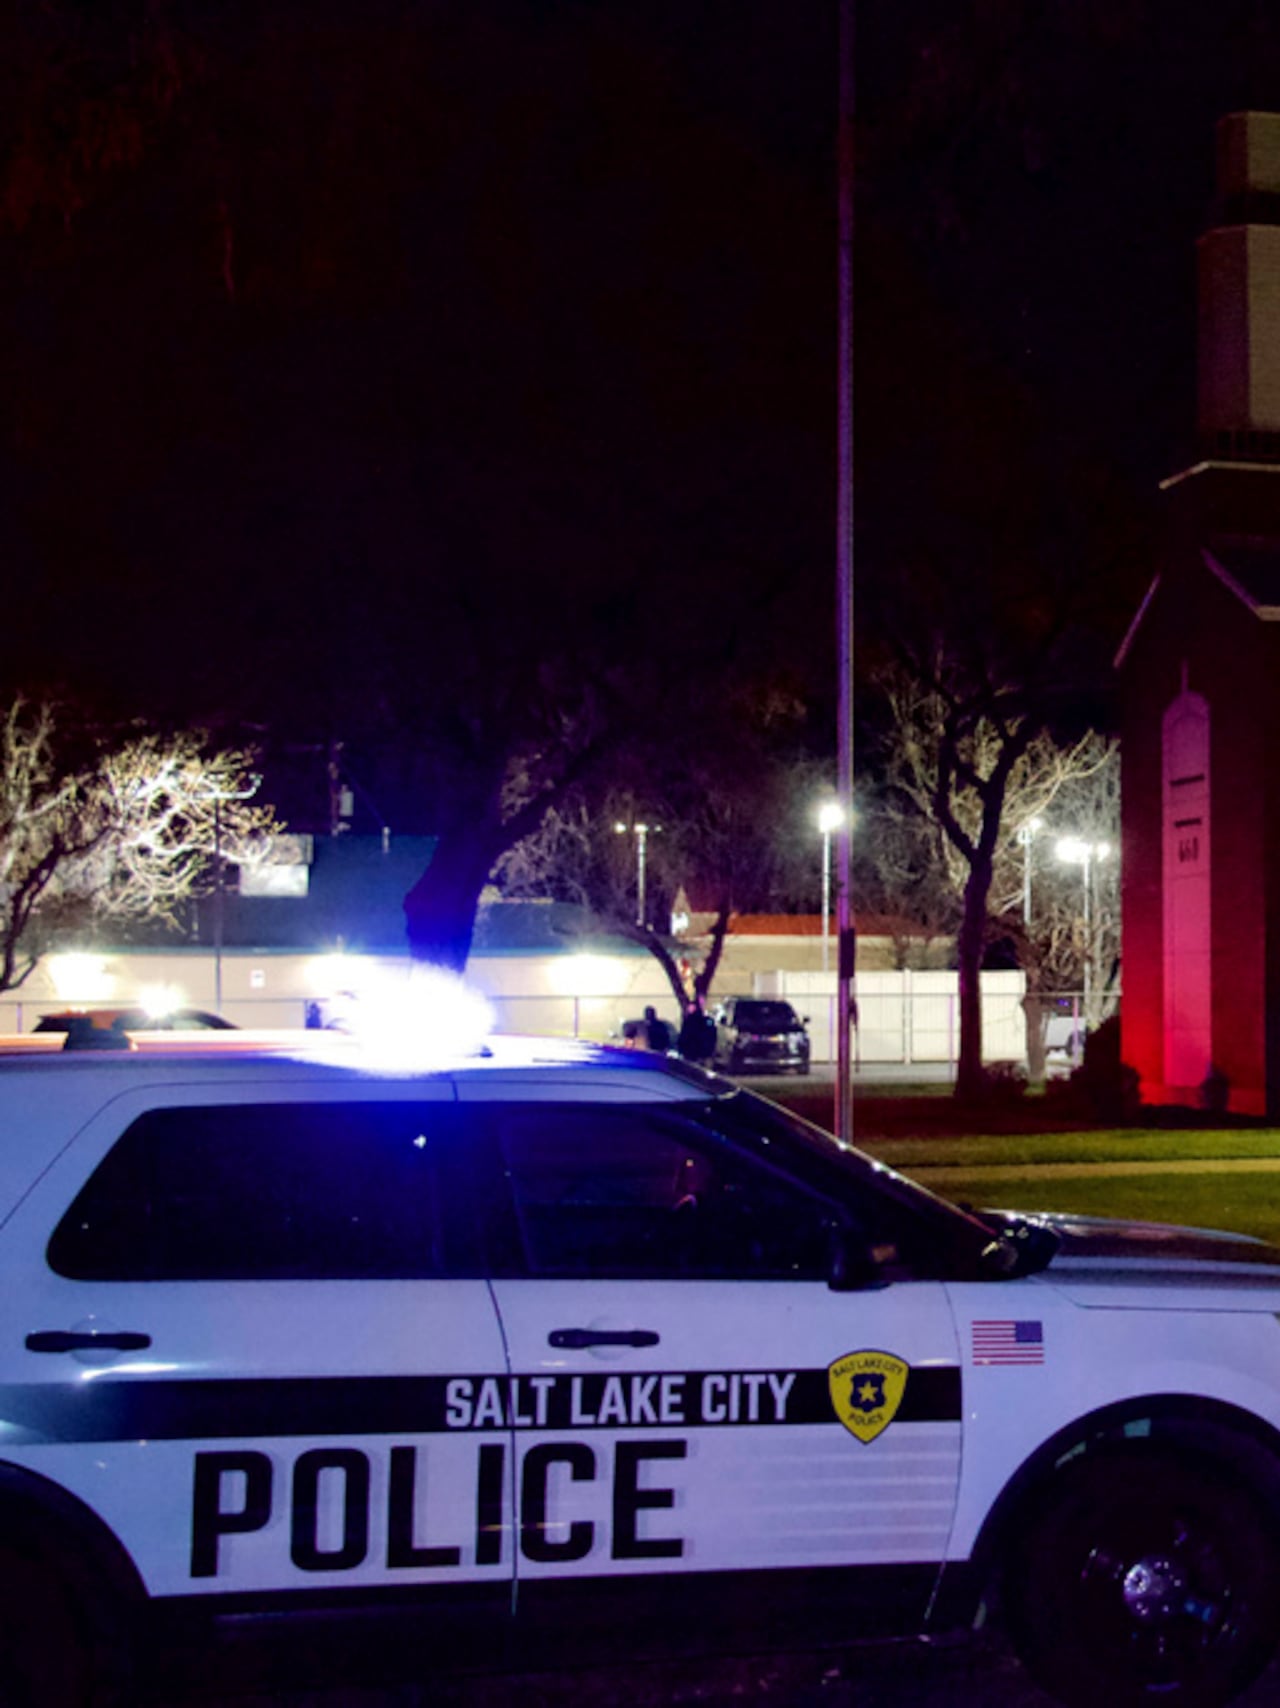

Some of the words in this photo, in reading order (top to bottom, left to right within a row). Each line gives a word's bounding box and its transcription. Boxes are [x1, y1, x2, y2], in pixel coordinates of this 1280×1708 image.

[446, 1377, 555, 1427] SALT
[570, 1375, 686, 1425] LAKE
[701, 1373, 796, 1422] CITY
[190, 1439, 688, 1578] POLICE
